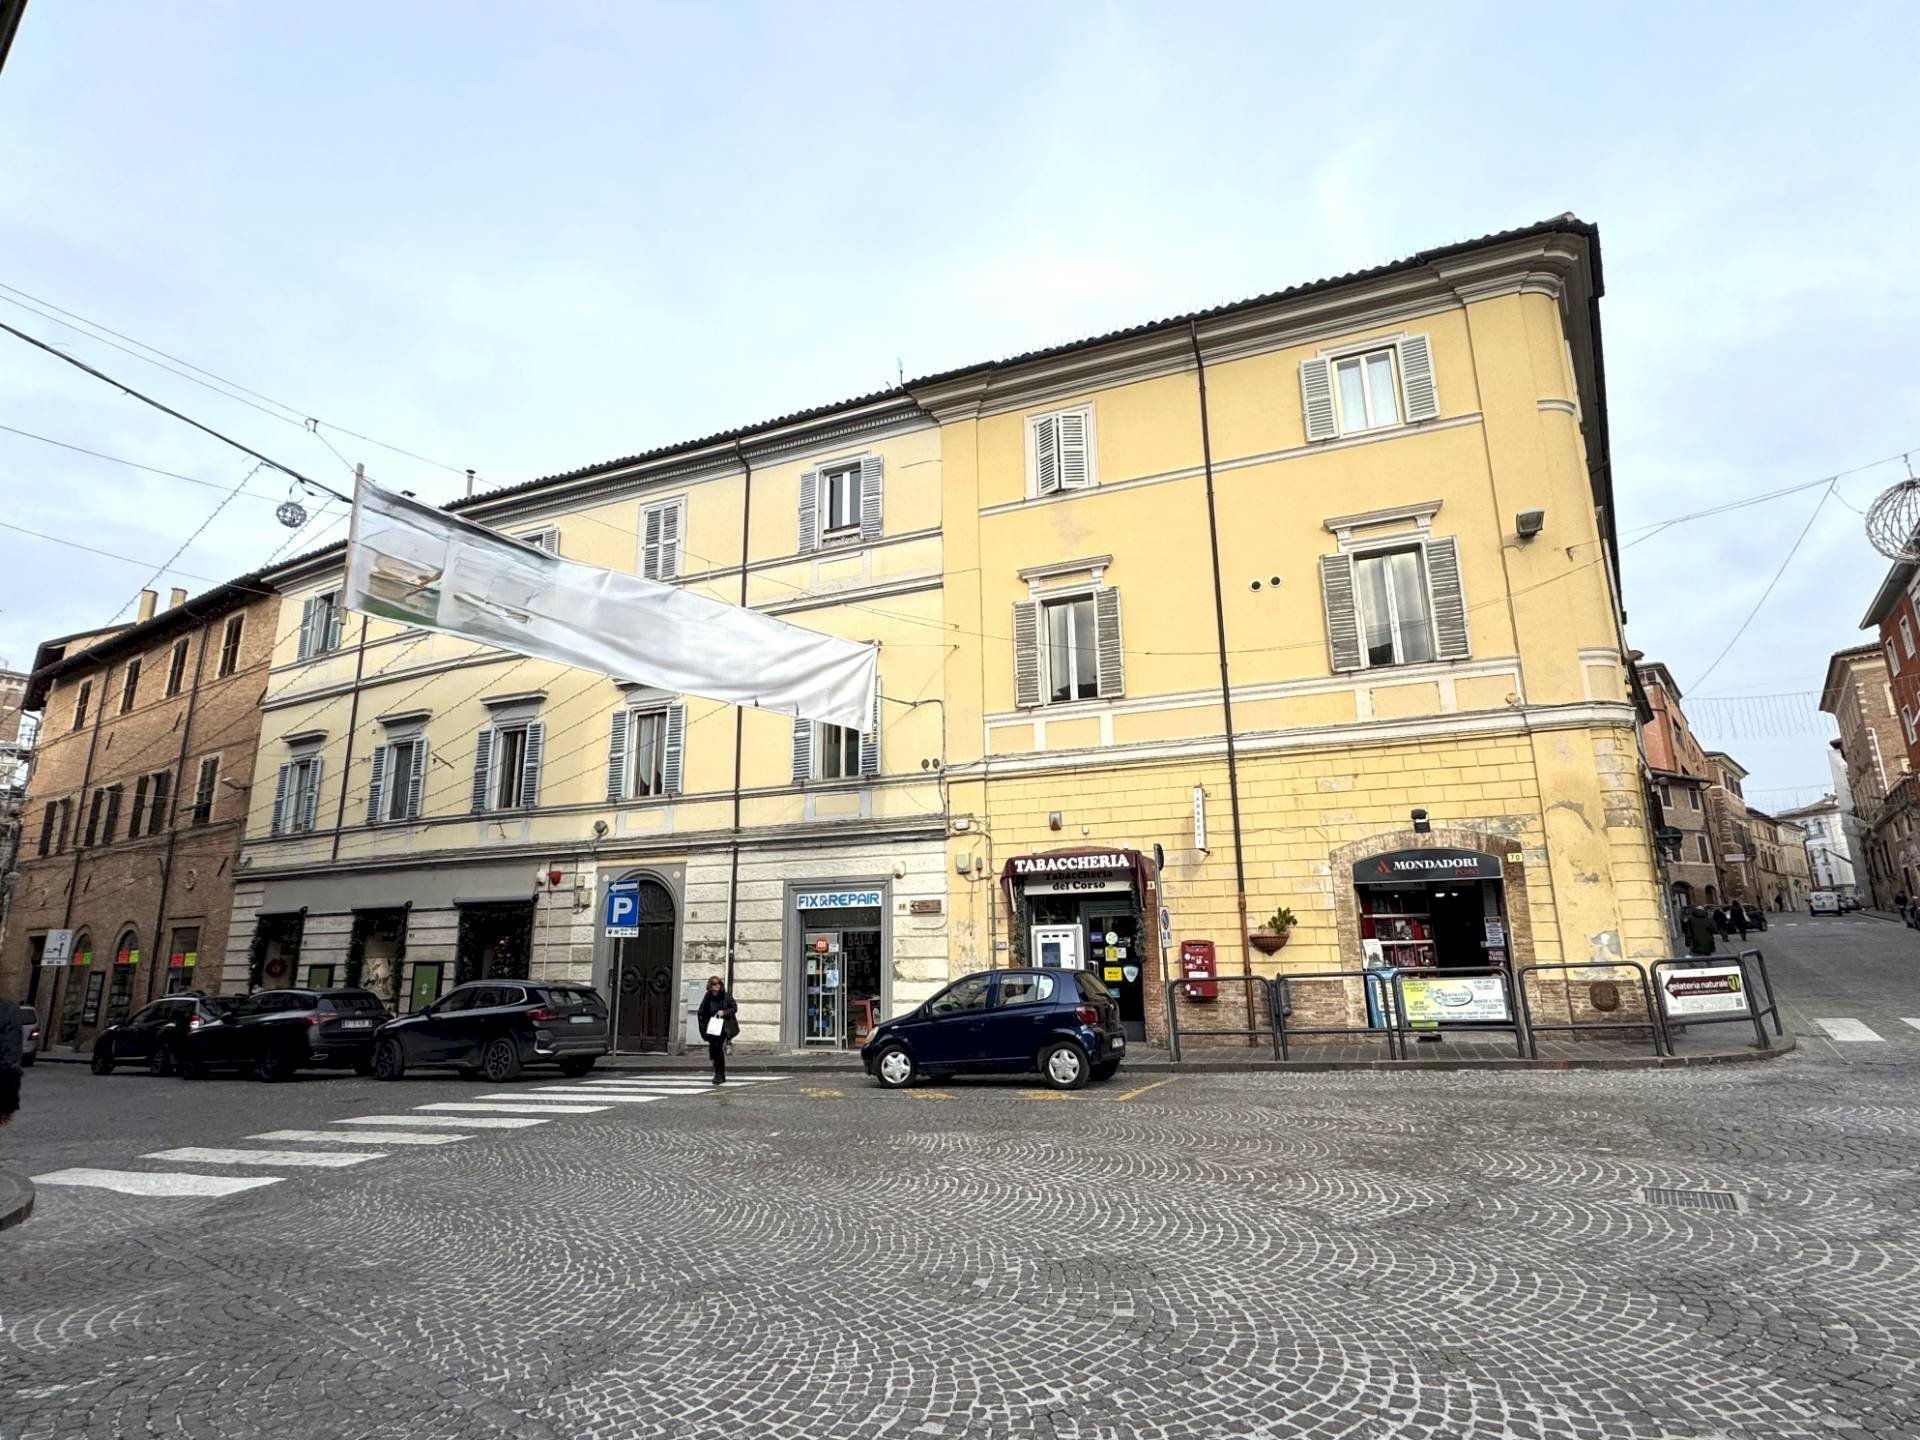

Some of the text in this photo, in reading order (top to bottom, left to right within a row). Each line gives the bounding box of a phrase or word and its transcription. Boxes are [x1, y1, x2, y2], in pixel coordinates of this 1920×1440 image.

[1014, 853, 1130, 873] TABACCHERIA
[1393, 857, 1479, 870] MONDADORI
[1510, 854, 1520, 862] 70
[1052, 880, 1106, 892] del Corso
[798, 892, 880, 907] FIX&REPAIR
[612, 896, 633, 924] P
[1668, 982, 1700, 993] gelateria
[1700, 979, 1728, 989] naturale
